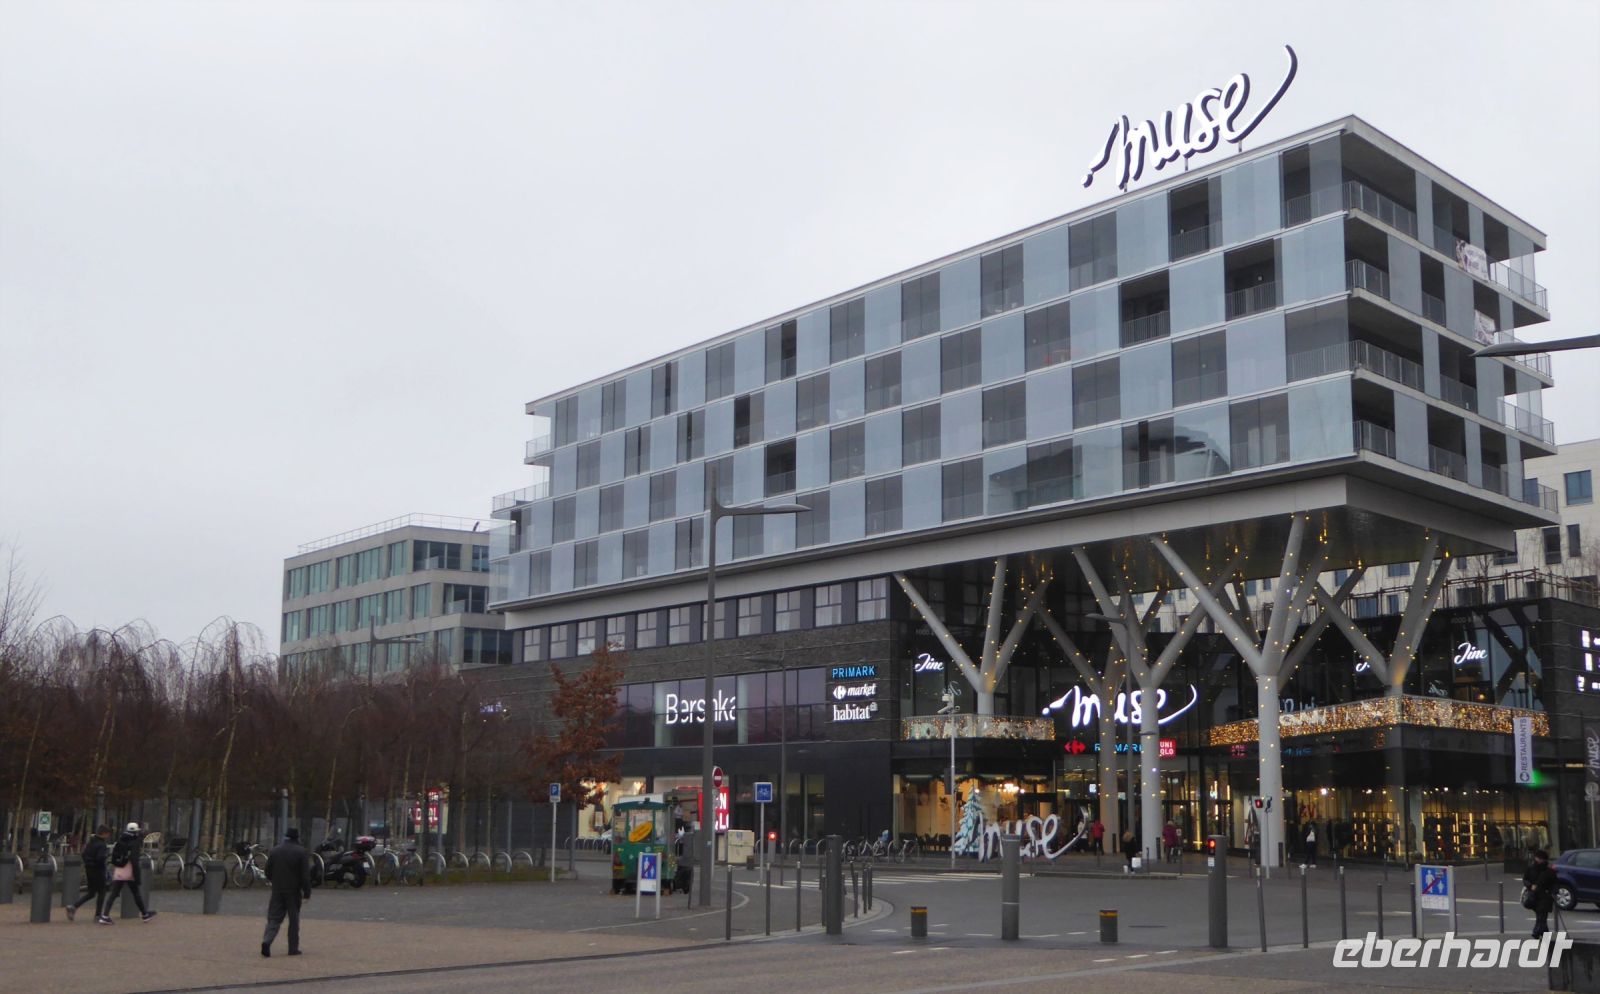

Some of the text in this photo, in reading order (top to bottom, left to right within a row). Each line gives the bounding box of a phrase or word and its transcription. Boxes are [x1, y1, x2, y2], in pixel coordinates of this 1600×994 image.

[1081, 44, 1298, 189] muse
[832, 665, 875, 678] PRIMARK
[847, 683, 877, 697] market
[832, 703, 872, 721] habitat
[1159, 748, 1175, 756] QLO
